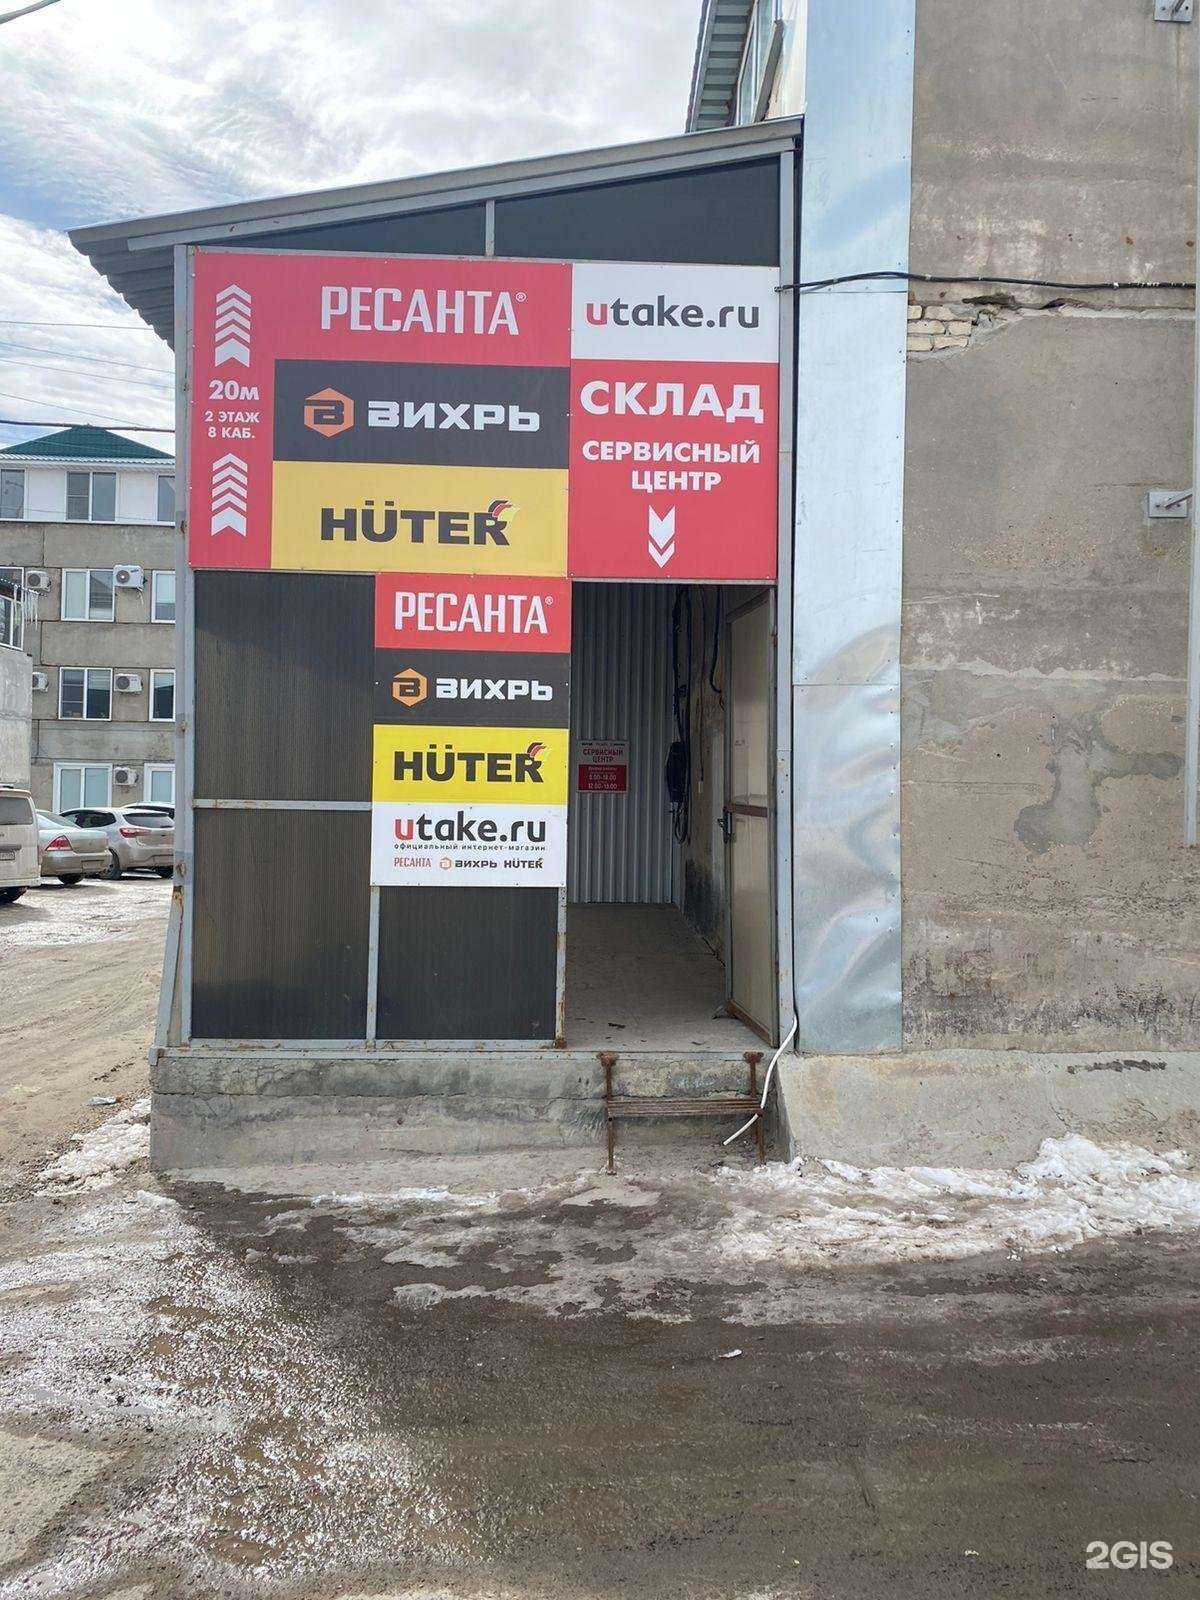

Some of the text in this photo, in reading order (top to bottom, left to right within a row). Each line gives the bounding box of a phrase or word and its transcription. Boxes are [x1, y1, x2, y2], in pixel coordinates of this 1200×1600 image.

[586, 295, 760, 328] utake.ru
[580, 380, 764, 424] СКЛАД
[204, 410, 260, 423] 2 ЭТАЖ
[368, 401, 540, 432] ВИХРЬ
[208, 426, 255, 439] 8 КАБ.
[582, 439, 760, 464] СЕРВИСНЫЙ
[631, 470, 722, 493] ЦЕНТР
[320, 500, 513, 546] HÜTER
[436, 678, 553, 701] ВИХРЬ
[393, 743, 546, 783] HÜTER
[394, 810, 546, 842] utake.ru
[394, 842, 546, 852] официальный интернет-магазин
[394, 857, 543, 869] РЕСАНТА ВИХРЬ HÜTER
